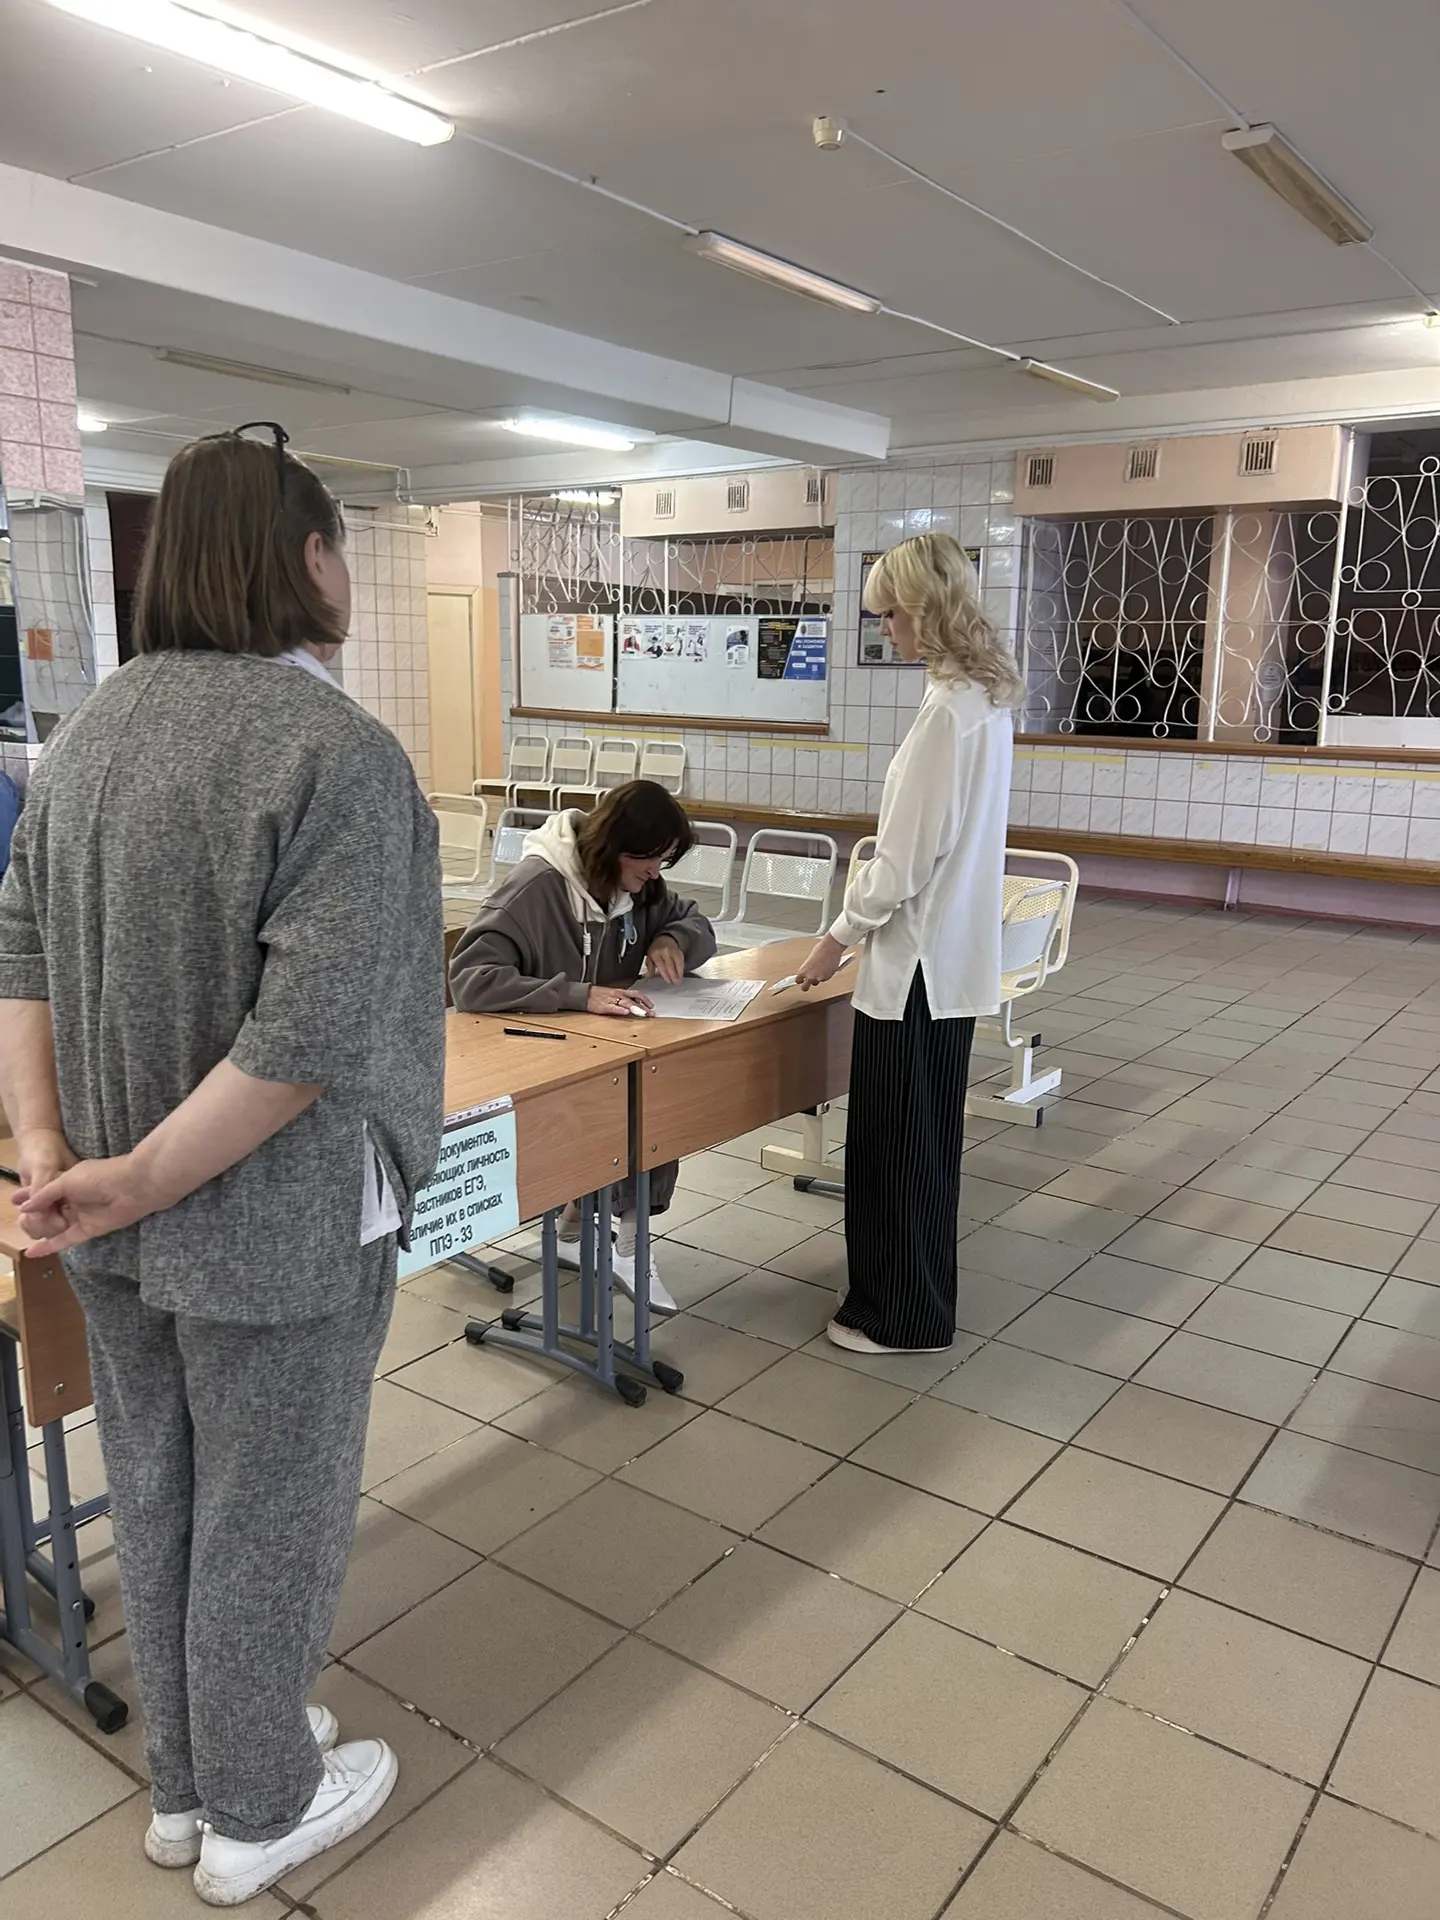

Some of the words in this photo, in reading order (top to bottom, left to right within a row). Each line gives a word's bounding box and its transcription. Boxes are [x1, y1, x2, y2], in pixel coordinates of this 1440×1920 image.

[439, 1130, 497, 1164] документов,
[424, 1163, 465, 1192] ряющих
[467, 1147, 510, 1173] личность
[414, 1186, 462, 1215] частников
[464, 1174, 487, 1196] ЕГЭ,
[409, 1217, 444, 1242] аличие
[445, 1211, 458, 1227] их
[459, 1208, 466, 1221] в
[467, 1192, 503, 1218] списках
[430, 1233, 453, 1256] ППЭ
[460, 1224, 473, 1243] 33
